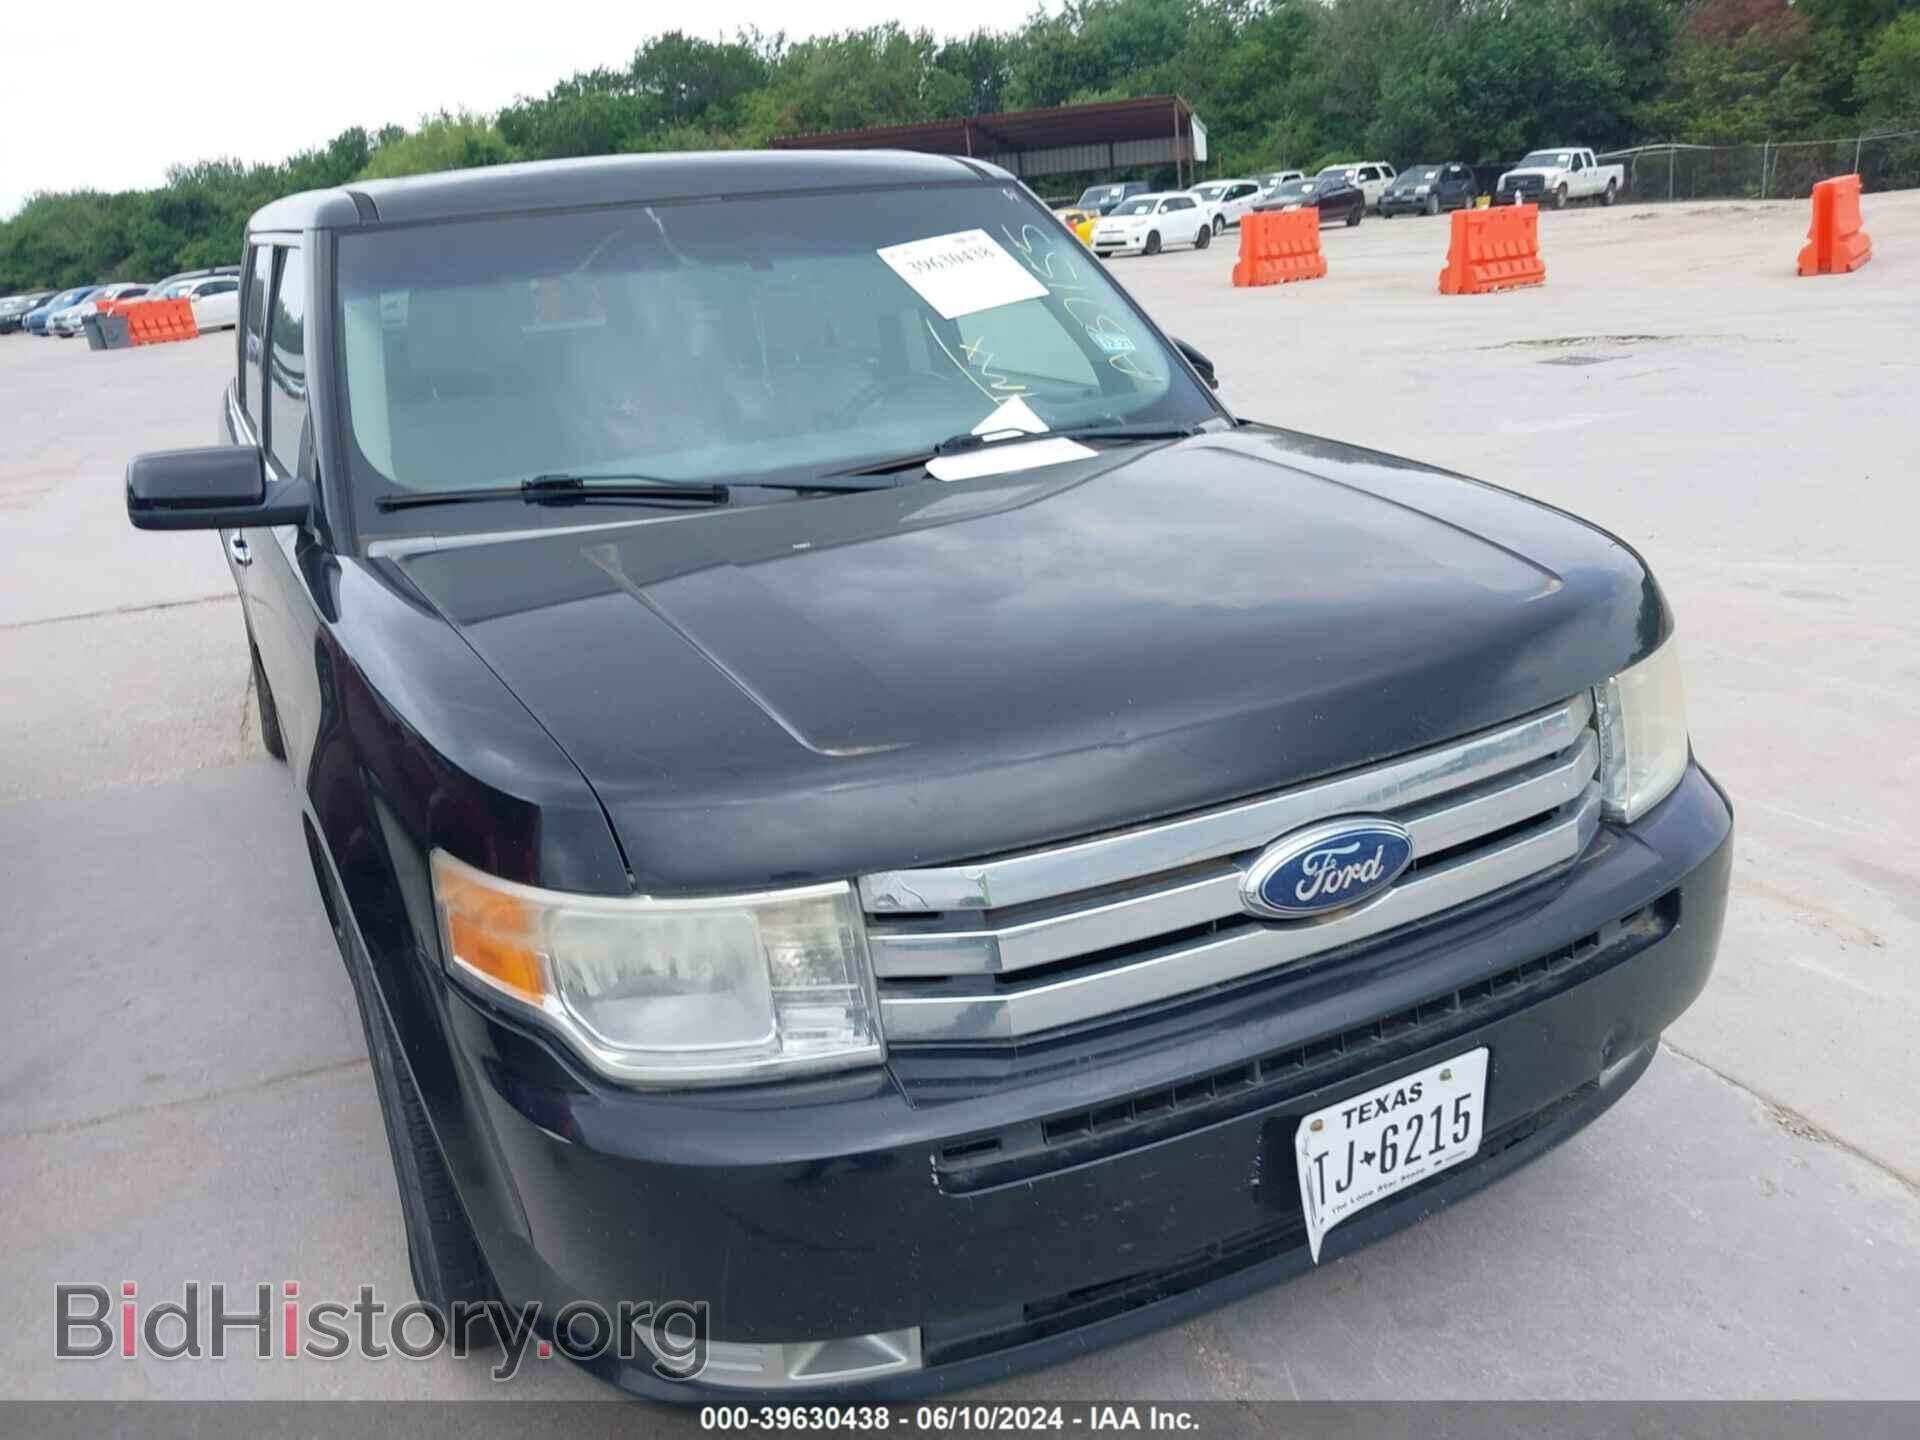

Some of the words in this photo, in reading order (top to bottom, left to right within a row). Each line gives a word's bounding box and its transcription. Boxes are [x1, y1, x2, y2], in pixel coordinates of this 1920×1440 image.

[1295, 841, 1384, 901] Ford
[1342, 1081, 1423, 1129] TEXAS
[1379, 1092, 1472, 1175] 6215
